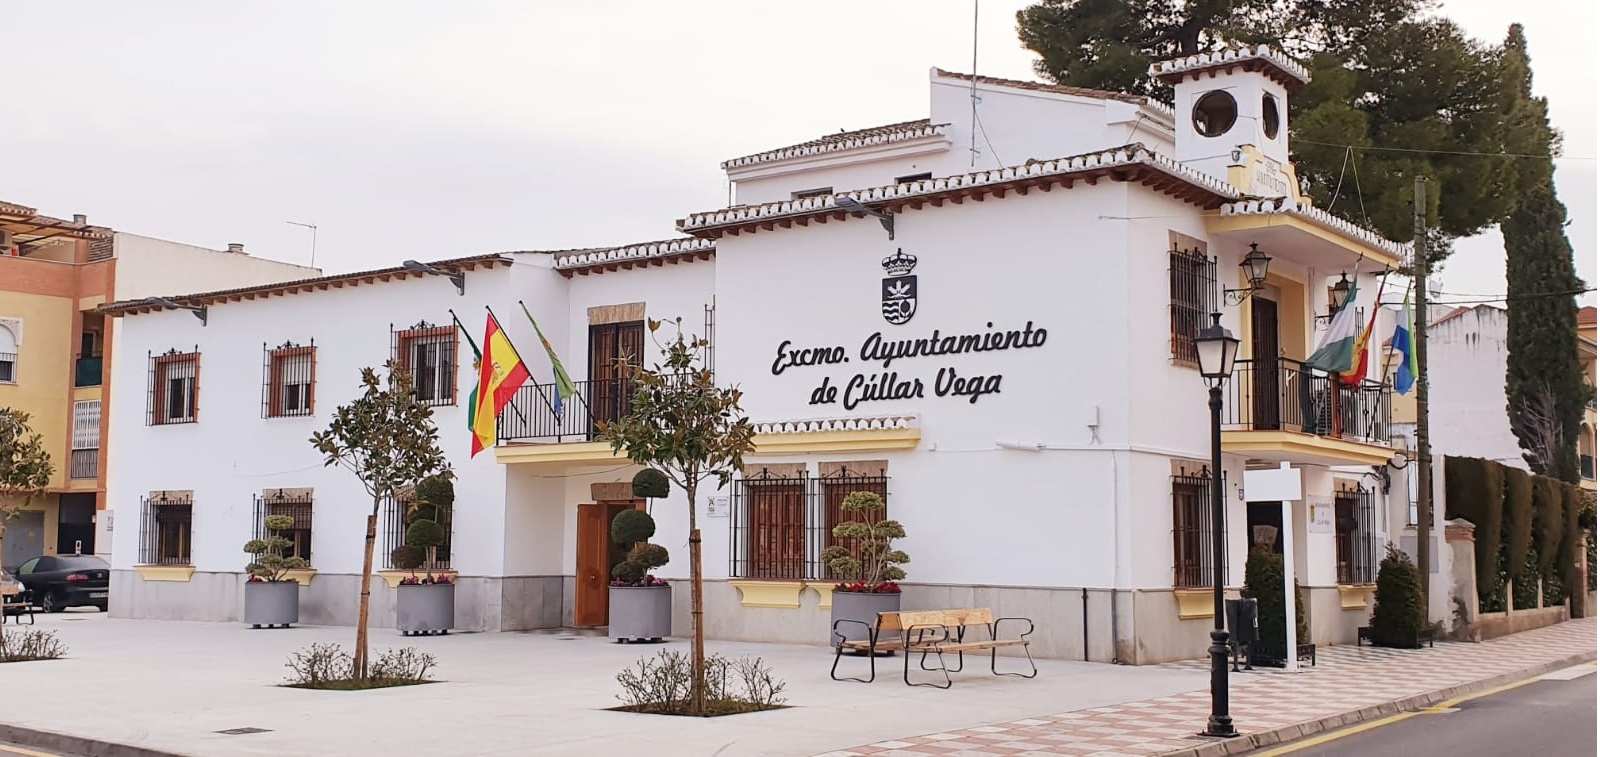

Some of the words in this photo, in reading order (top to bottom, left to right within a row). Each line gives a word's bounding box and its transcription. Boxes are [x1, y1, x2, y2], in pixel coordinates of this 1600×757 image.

[771, 340, 850, 376] Excmo.
[859, 320, 1048, 368] Ayuntamiento
[808, 376, 838, 405] de
[843, 372, 924, 411] Cúllar
[934, 367, 1003, 404] Vega
